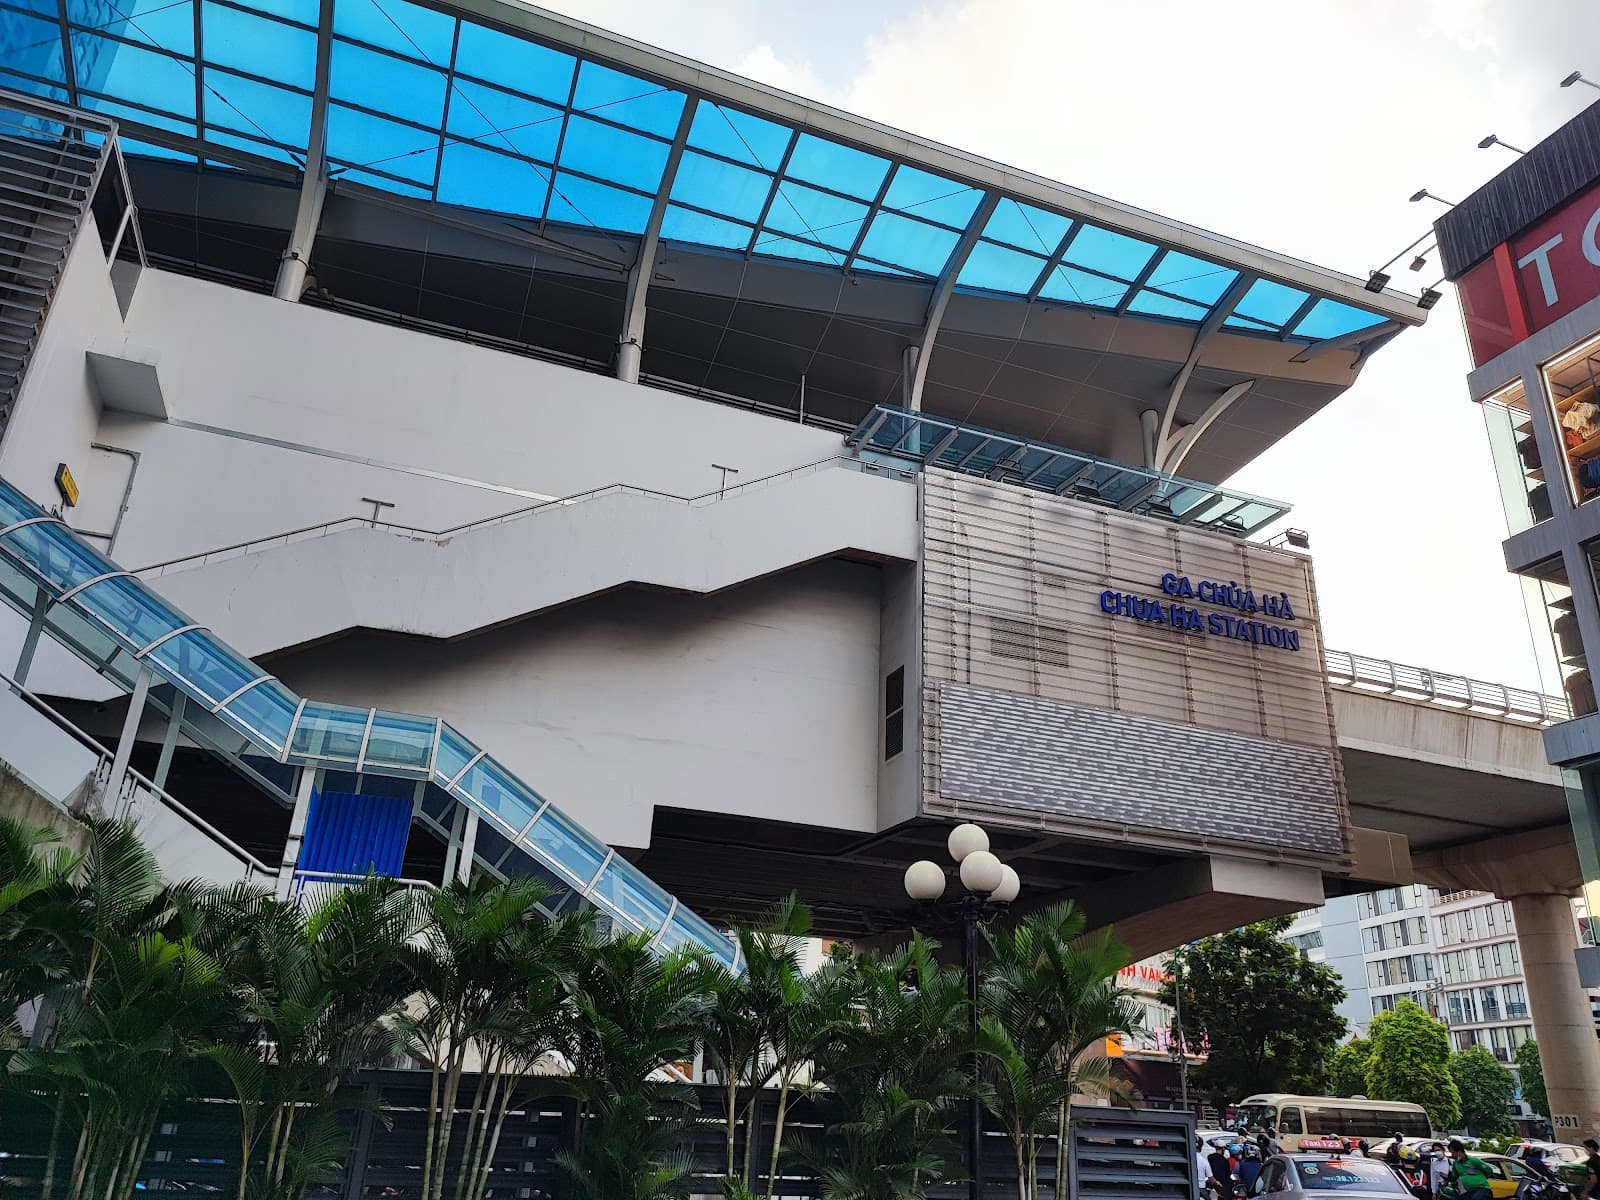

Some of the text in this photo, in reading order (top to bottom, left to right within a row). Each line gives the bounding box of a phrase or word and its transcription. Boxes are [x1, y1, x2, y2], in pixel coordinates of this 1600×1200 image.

[1162, 573, 1194, 599] GA
[1100, 590, 1300, 651] CHUA HA STATION
[1554, 1116, 1578, 1128] P301
